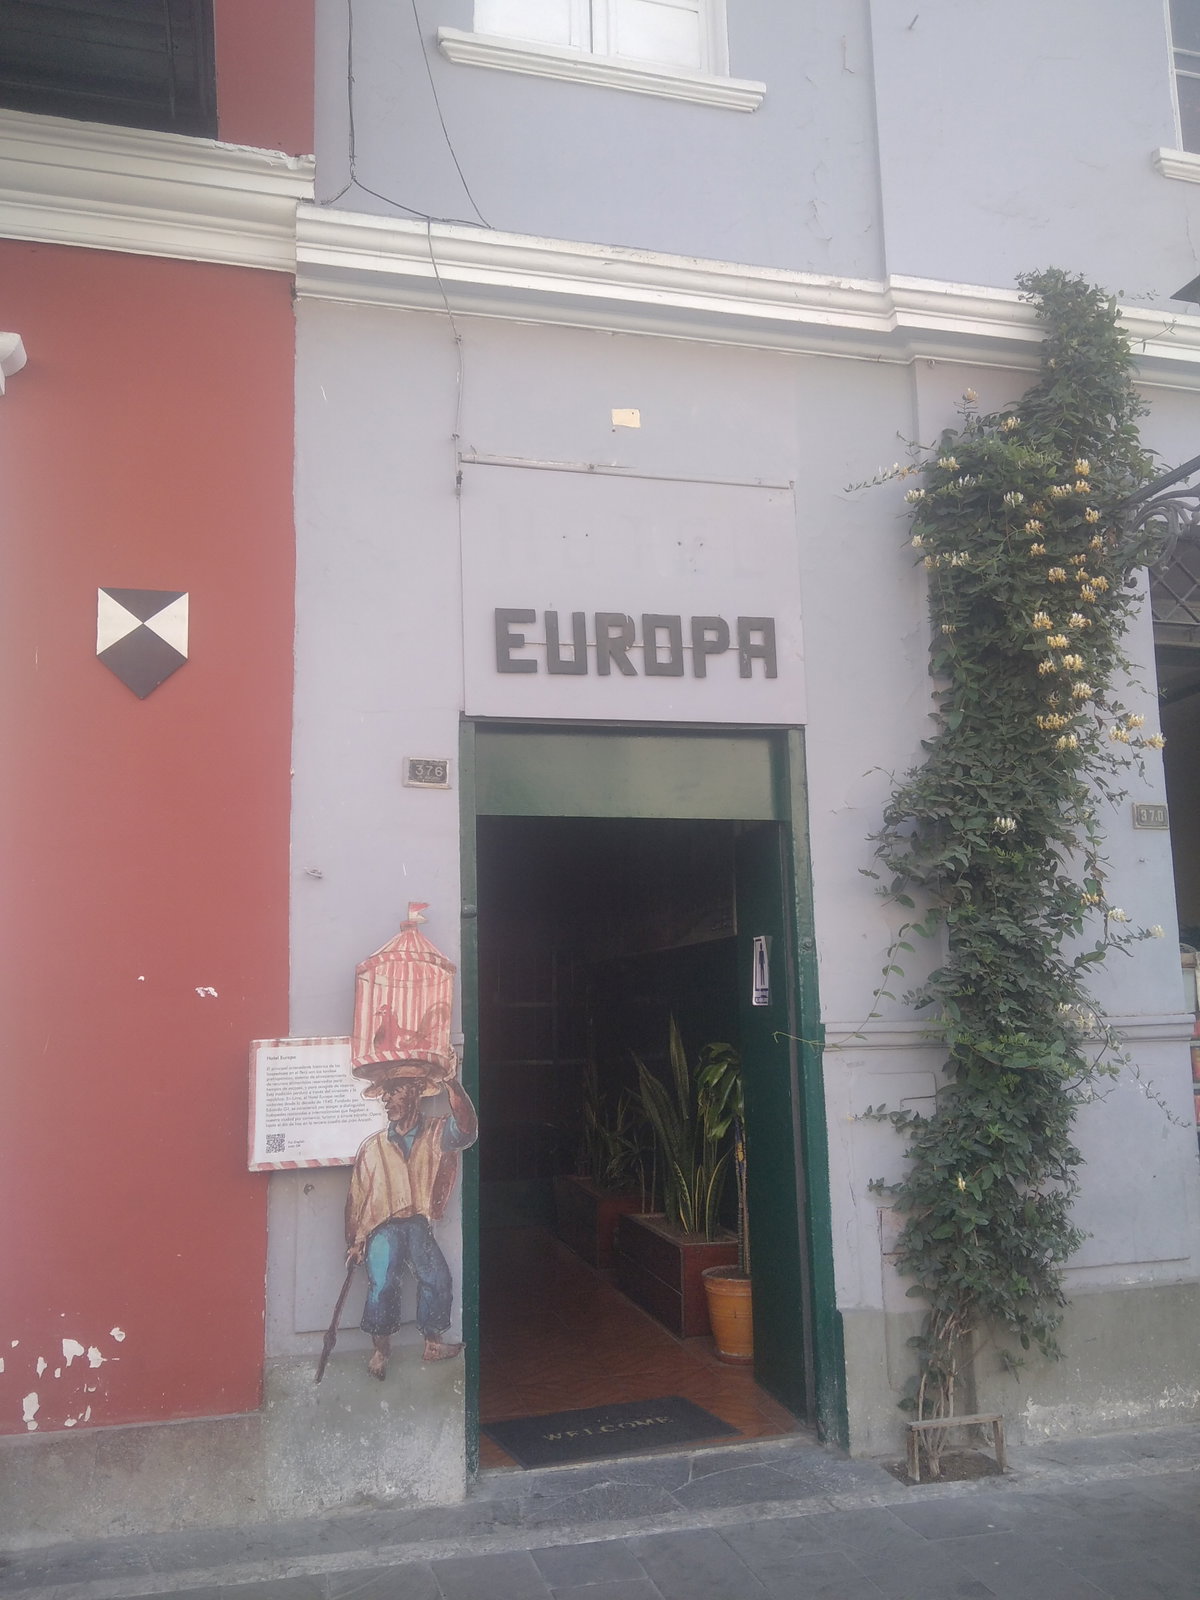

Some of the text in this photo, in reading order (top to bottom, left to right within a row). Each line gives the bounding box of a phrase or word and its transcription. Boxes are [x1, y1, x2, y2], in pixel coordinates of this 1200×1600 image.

[494, 607, 778, 679] EUROPA
[415, 764, 444, 777] 376
[543, 1416, 675, 1441] WELCOME
